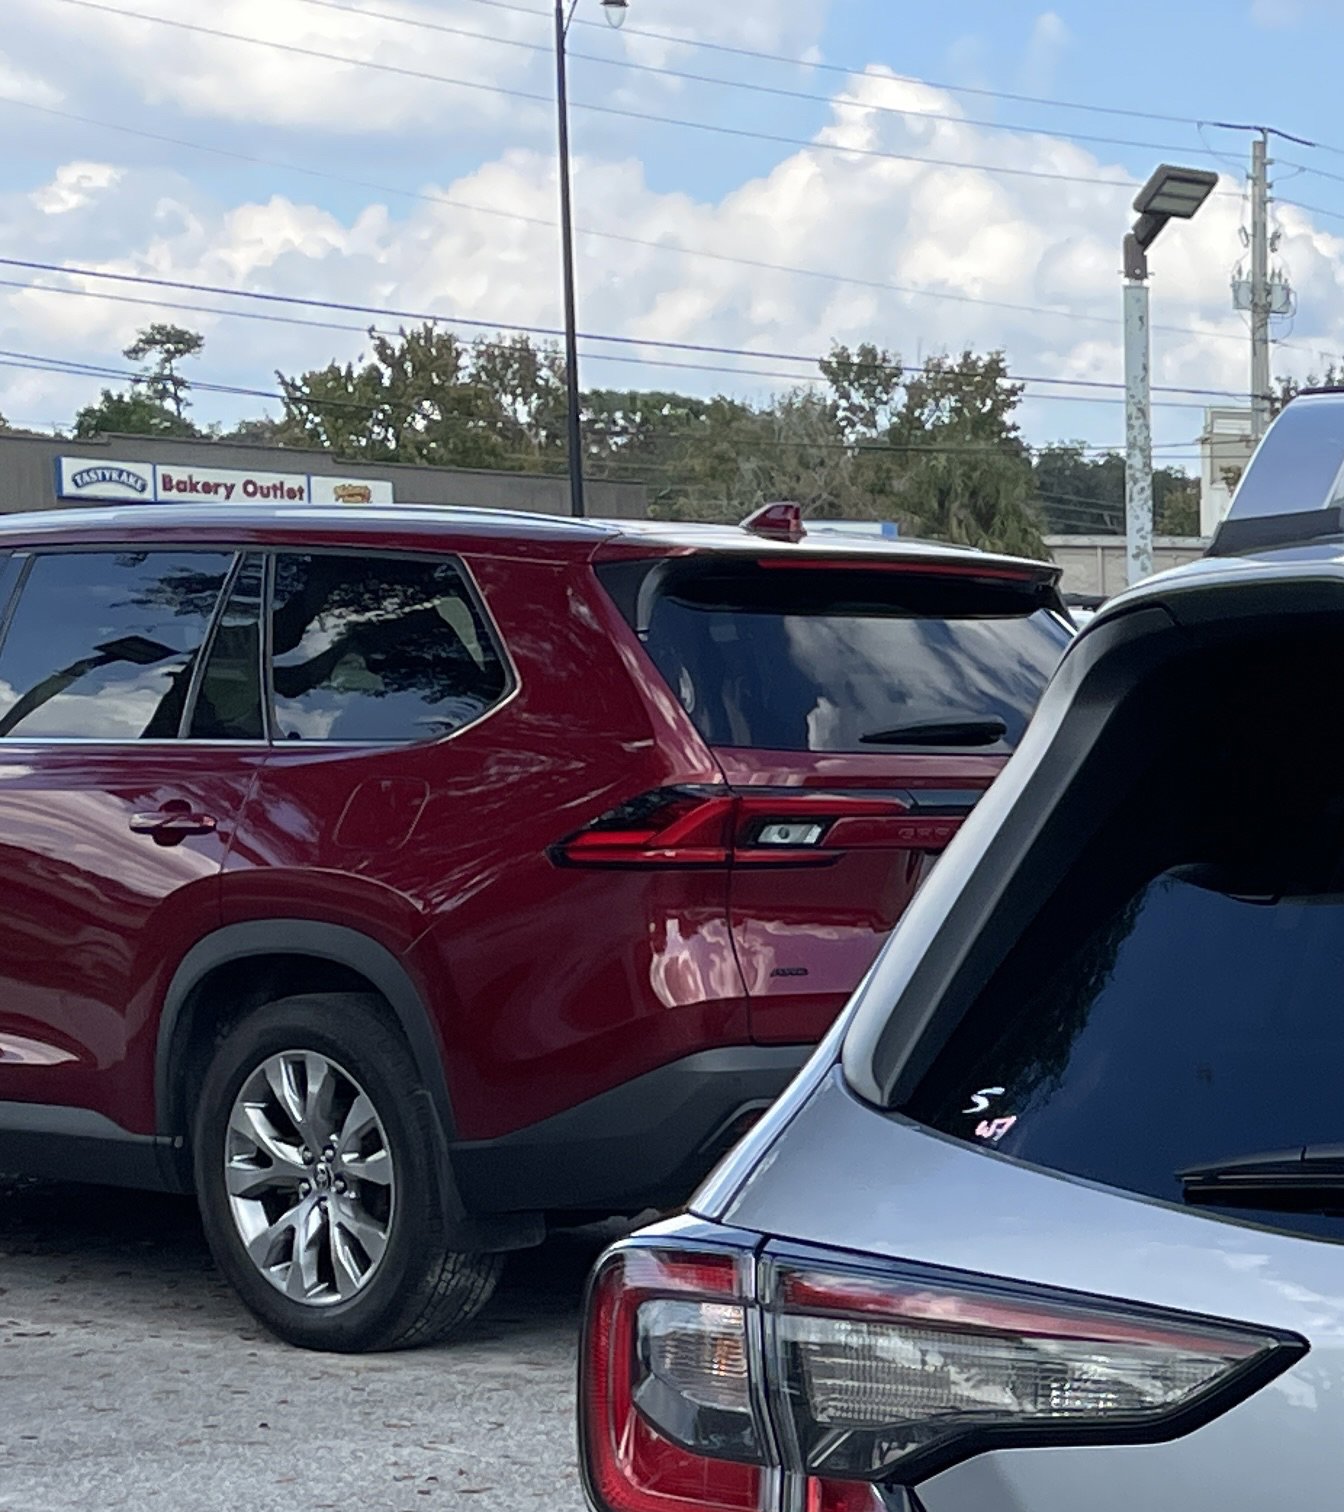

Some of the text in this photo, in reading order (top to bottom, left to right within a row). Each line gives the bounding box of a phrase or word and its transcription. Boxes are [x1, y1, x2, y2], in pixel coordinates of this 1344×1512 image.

[73, 467, 144, 492] TASTYKAKE
[161, 473, 236, 500] Bakery
[242, 479, 305, 501] Outlet
